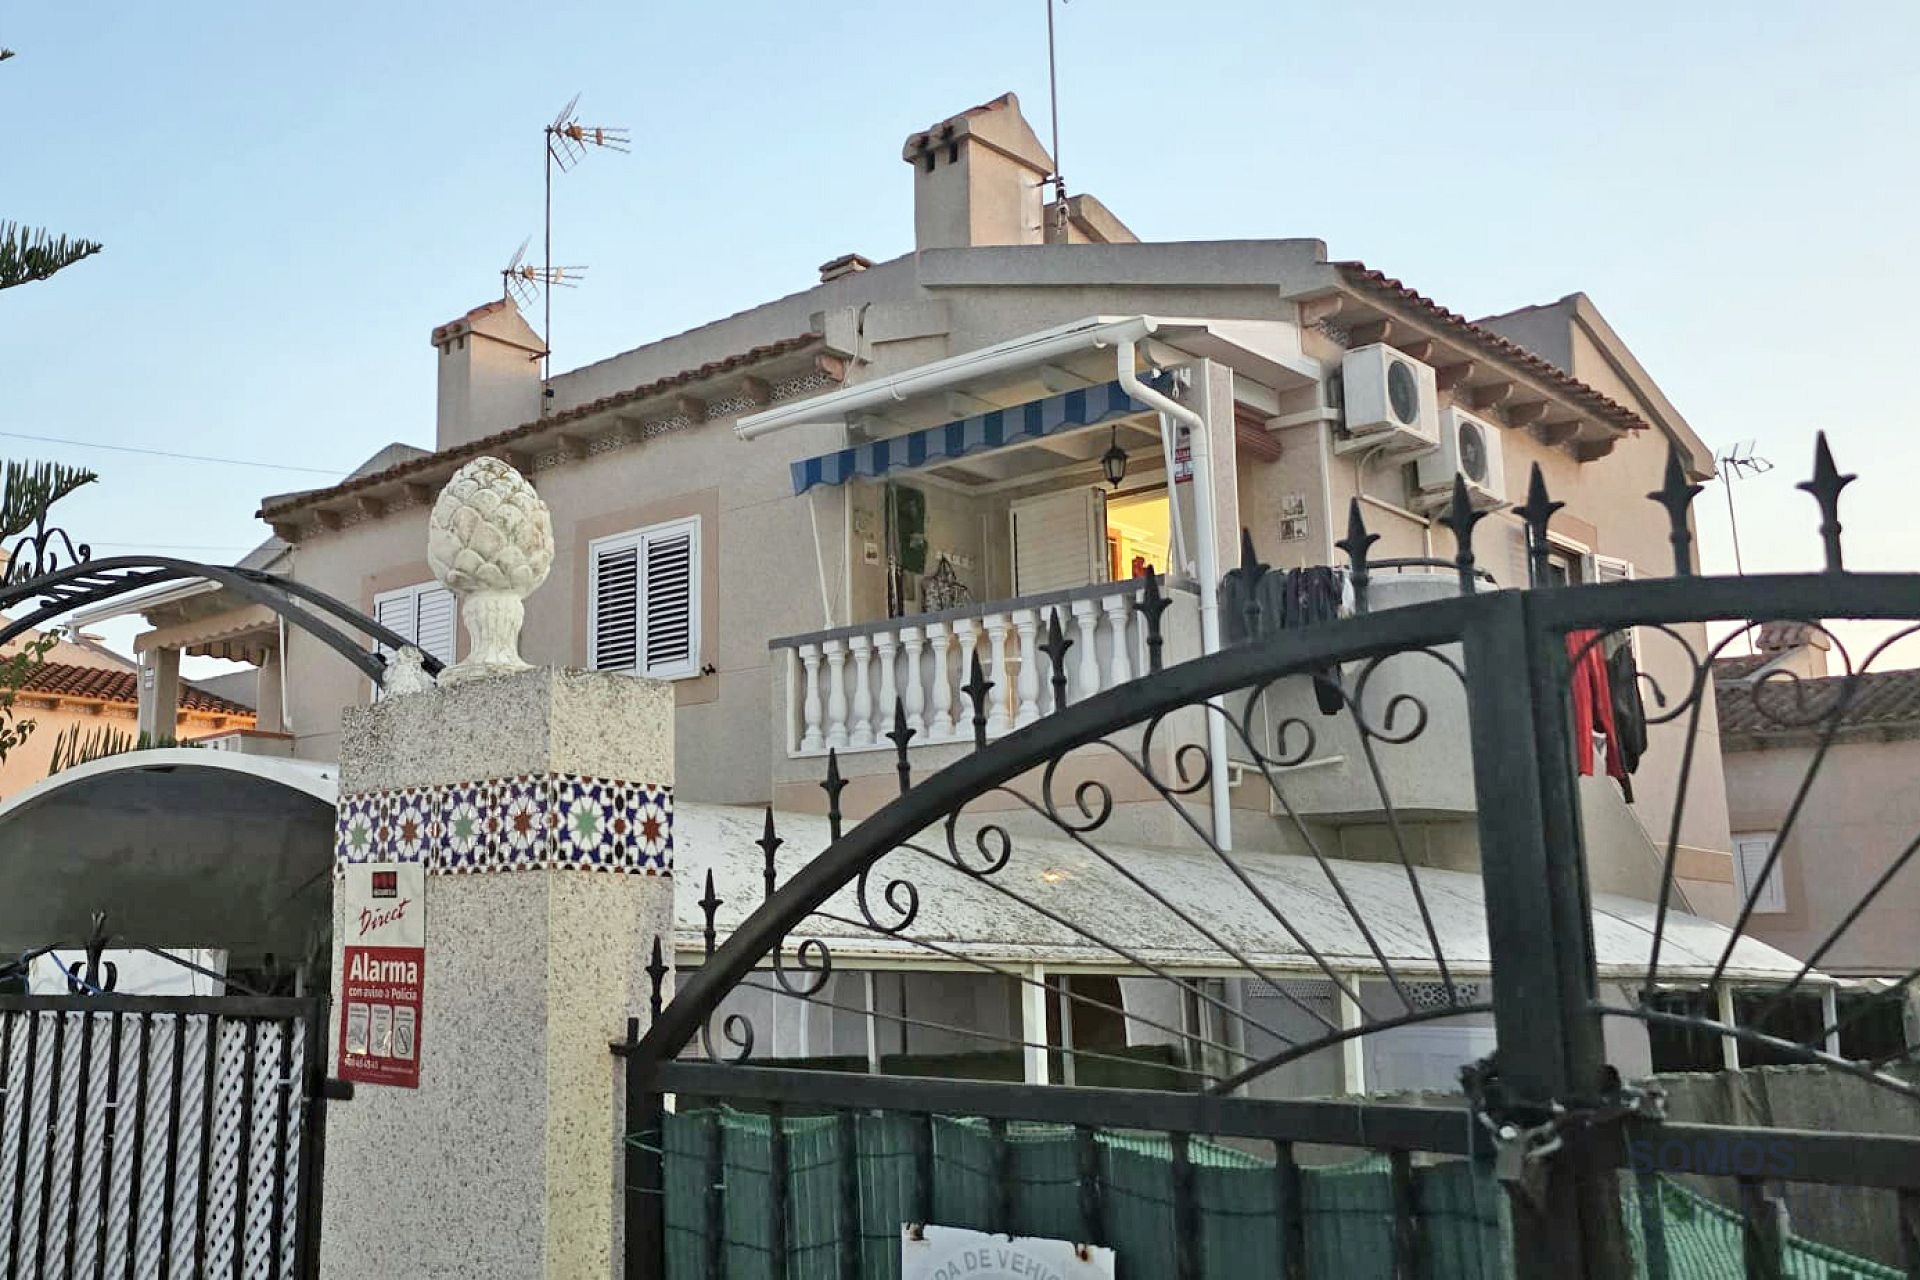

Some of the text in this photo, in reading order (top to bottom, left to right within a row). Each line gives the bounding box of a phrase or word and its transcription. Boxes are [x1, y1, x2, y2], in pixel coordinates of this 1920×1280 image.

[359, 898, 412, 936] Direct
[349, 953, 418, 984] Alarma
[932, 1260, 962, 1280] DA
[963, 1248, 993, 1272] DE
